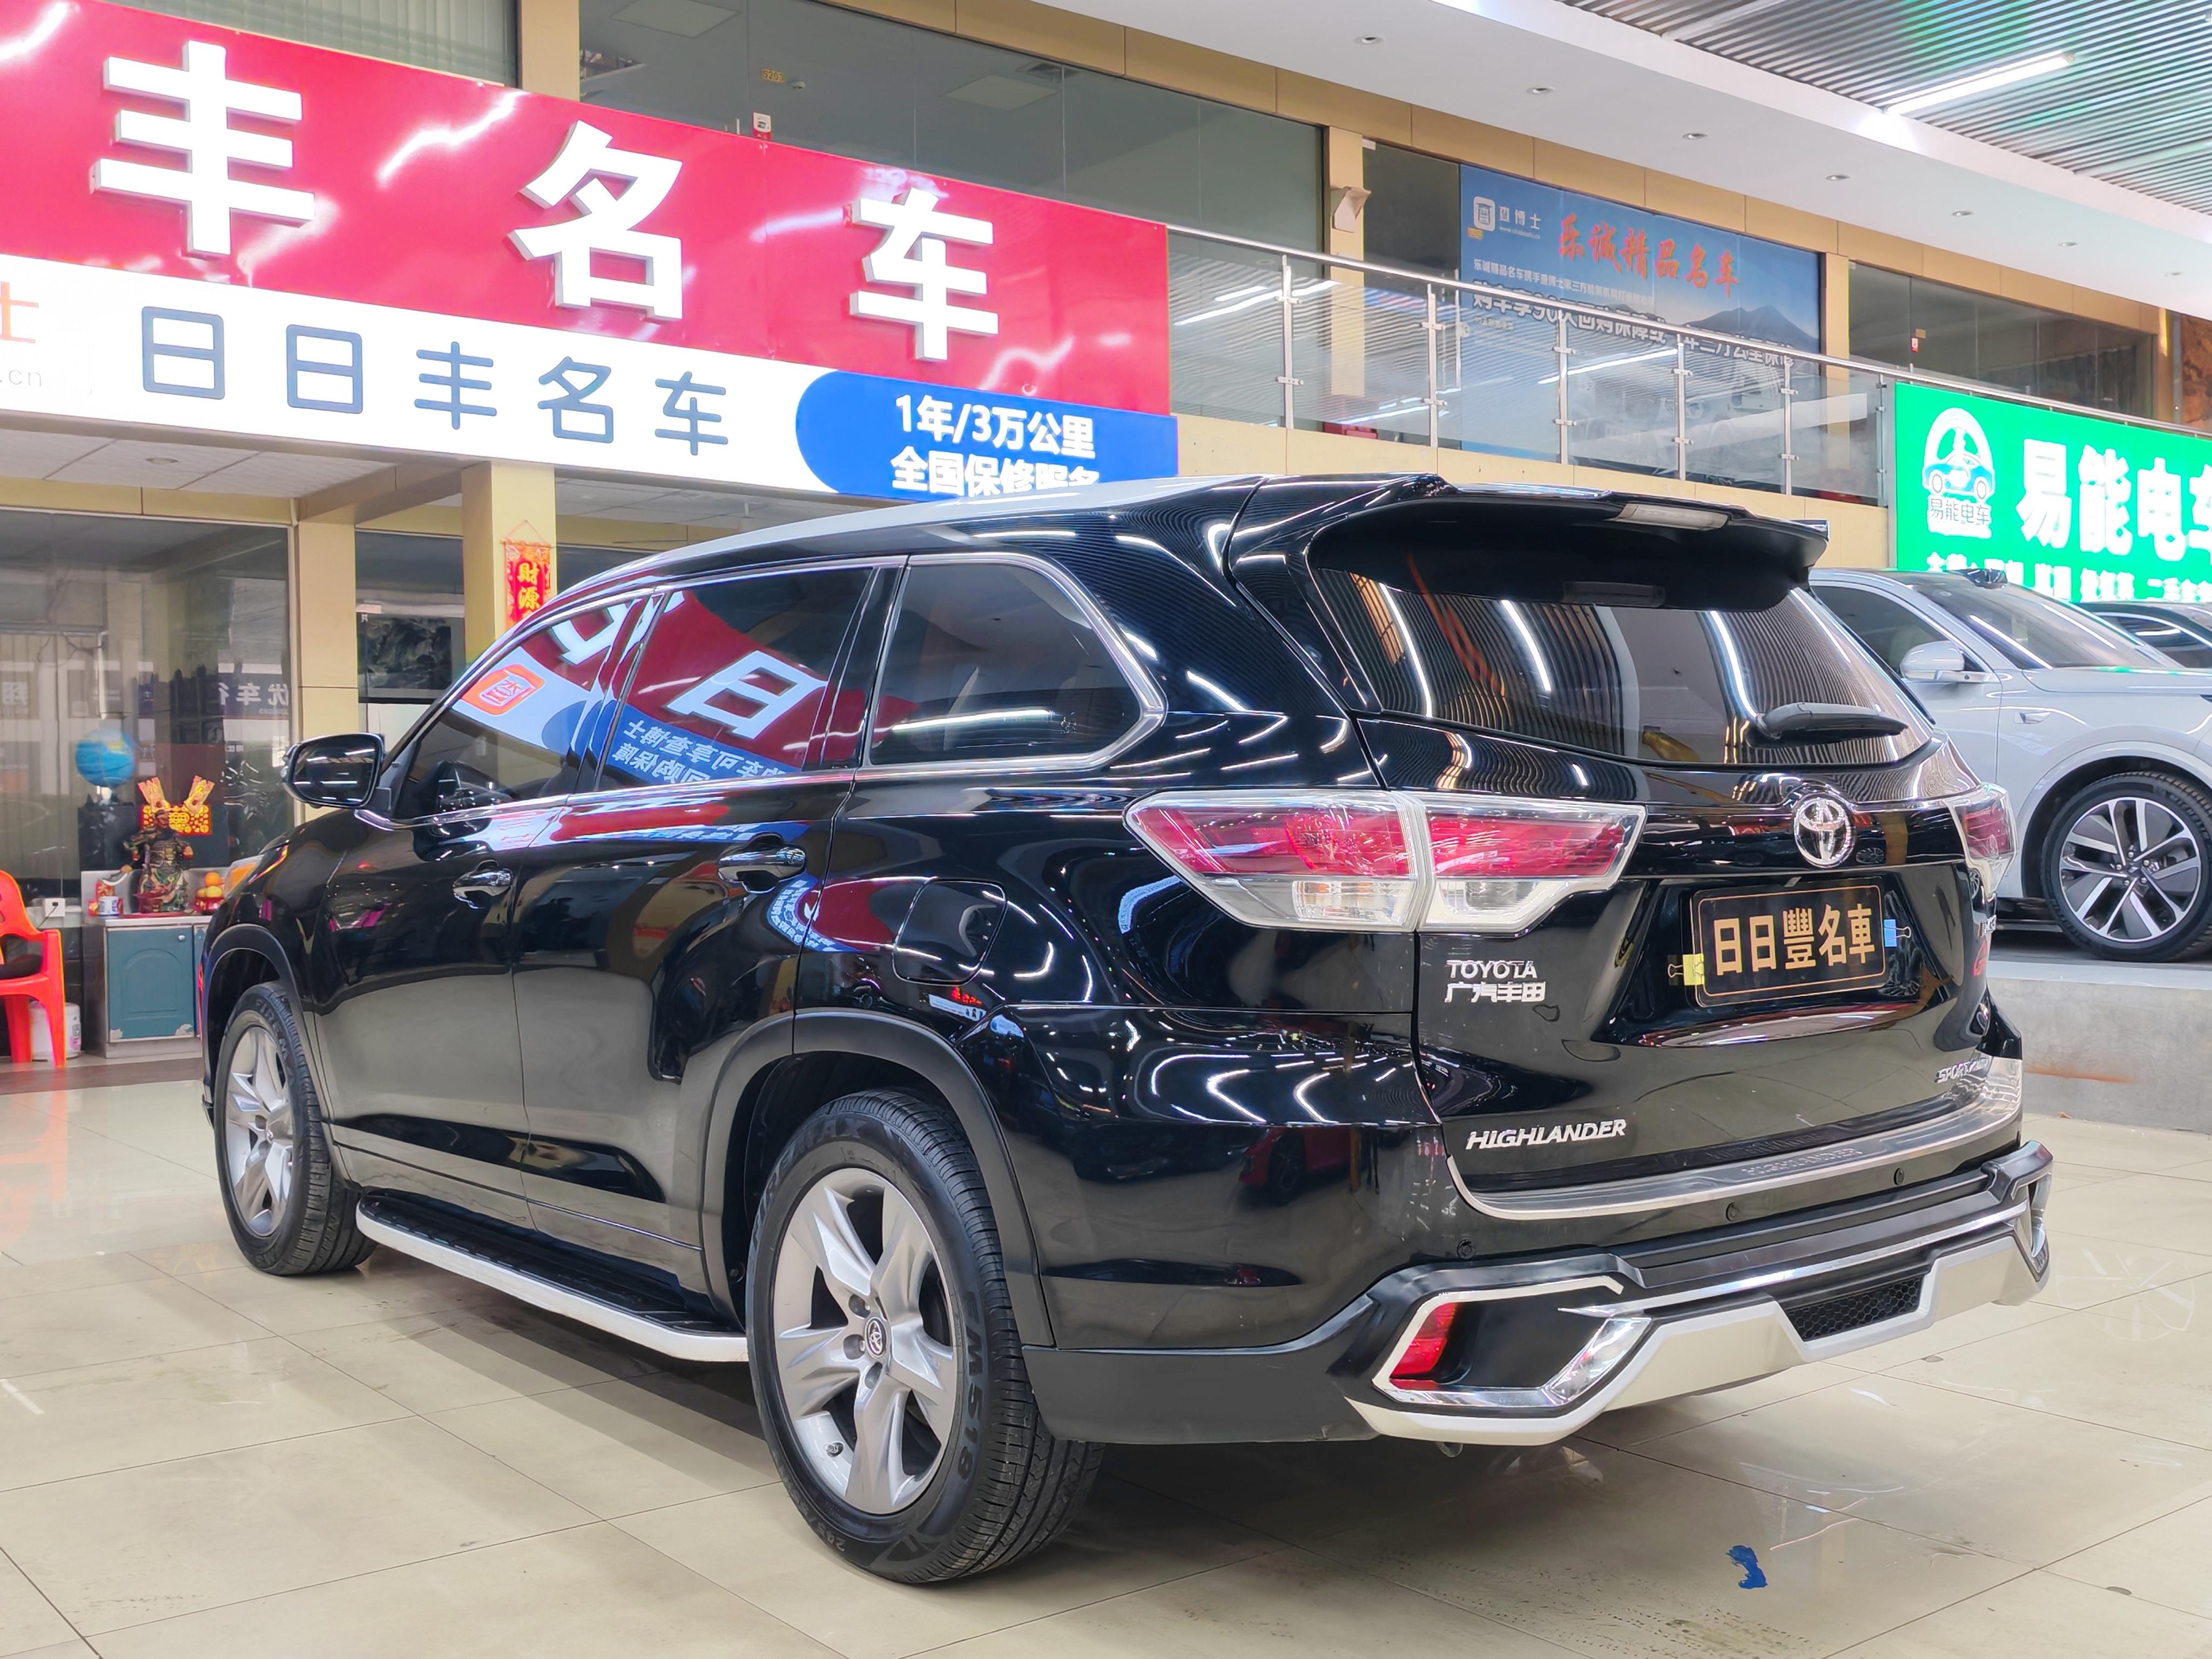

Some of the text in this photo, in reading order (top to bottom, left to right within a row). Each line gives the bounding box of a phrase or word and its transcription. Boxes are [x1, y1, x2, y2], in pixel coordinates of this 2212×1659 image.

[90, 40, 999, 361] 丰名车
[141, 306, 729, 456] 日日丰名车
[895, 394, 1096, 459] 1年/3万公里
[1931, 498, 1990, 524] 易能电车
[517, 562, 540, 619] 財源
[1713, 903, 1875, 976] 日日豐名車
[1444, 981, 1547, 1003] 广汽丰田
[1445, 960, 1538, 979] TOYOTA
[1465, 1119, 1627, 1150] HIGHLANDER
